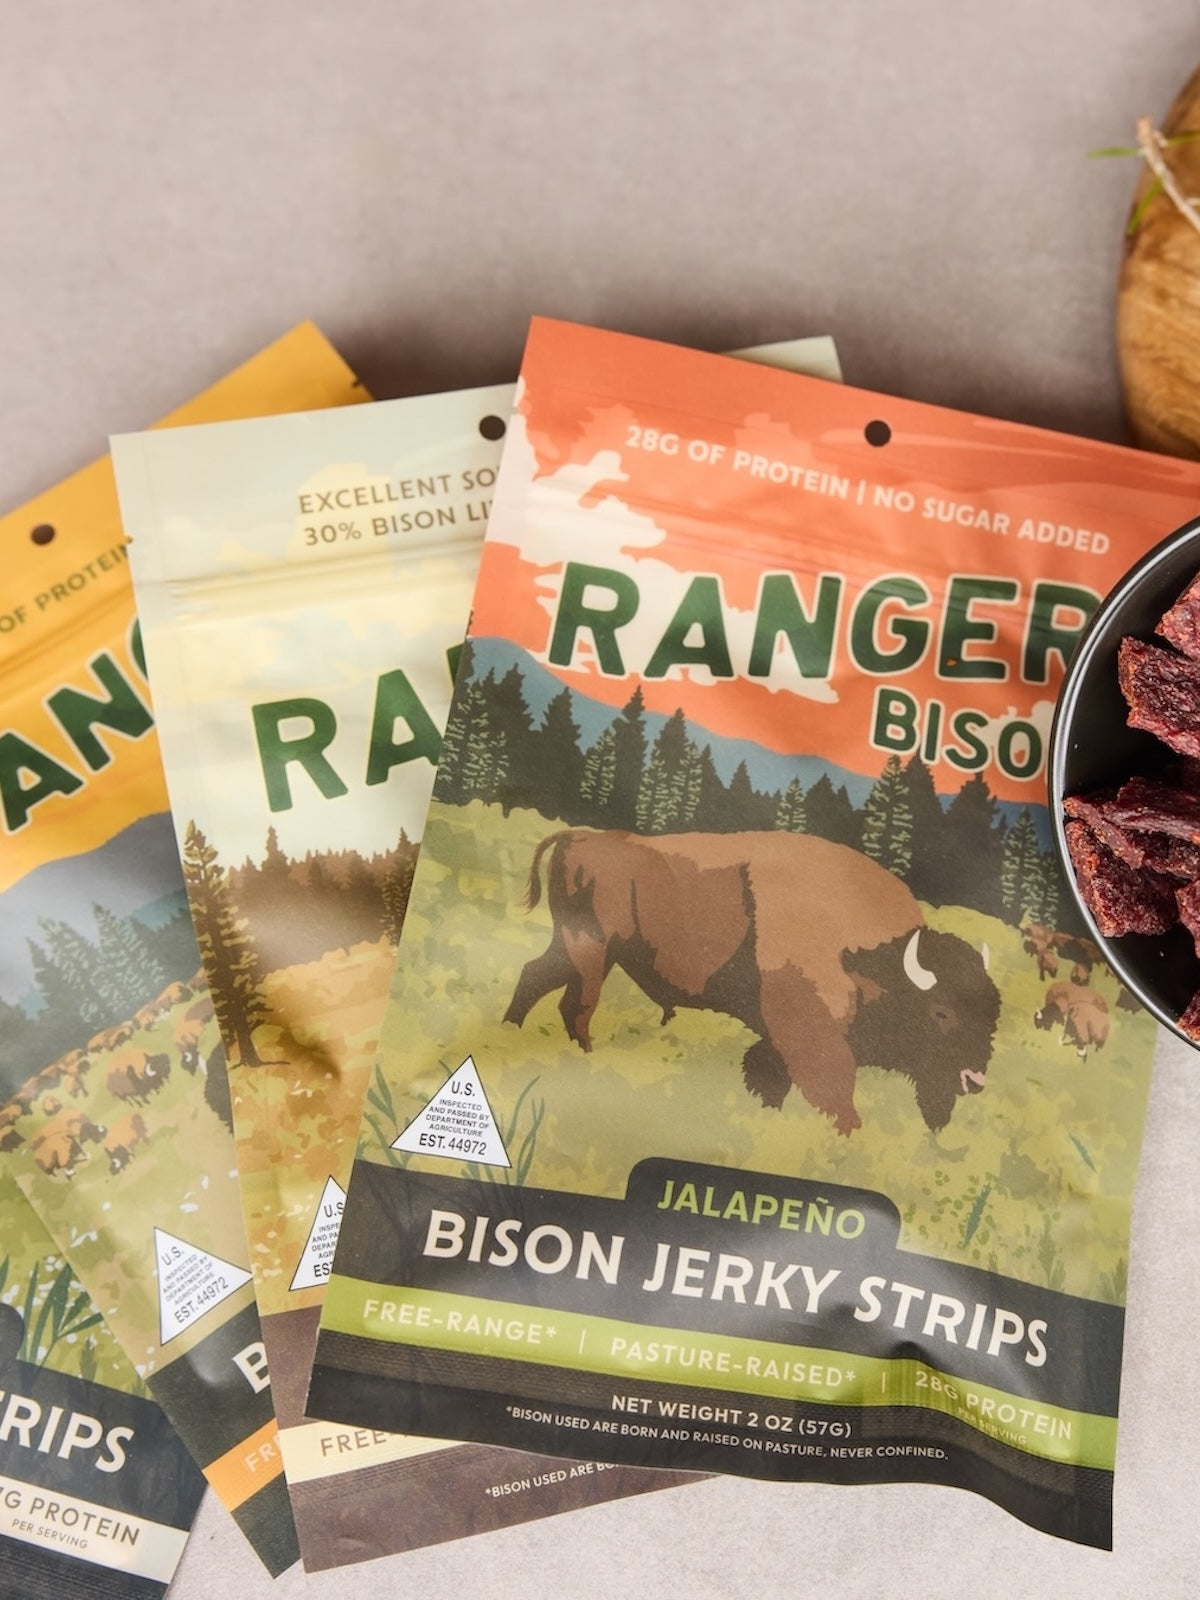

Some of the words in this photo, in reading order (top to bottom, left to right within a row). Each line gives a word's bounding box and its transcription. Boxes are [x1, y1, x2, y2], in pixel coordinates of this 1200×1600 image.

[298, 474, 453, 514] EXCELLENT
[462, 465, 500, 490] SO
[625, 425, 679, 456] 28G
[687, 439, 726, 465] OF
[732, 450, 850, 500] PROTEIN
[873, 484, 916, 513] NO
[922, 498, 1010, 535] SUGAR
[1017, 518, 1111, 555] ADDED
[304, 522, 362, 546] 30%
[371, 507, 456, 537] BISON
[466, 500, 493, 522] LI
[0, 605, 28, 632] OF
[546, 560, 1103, 684] RANGER
[251, 643, 465, 814] RA
[439, 1098, 483, 1112] INSPECTED
[451, 1080, 476, 1097] U.S.
[425, 1113, 478, 1128] DEPARTMENT
[478, 1121, 490, 1130] OF
[428, 1106, 446, 1114] AND
[447, 1108, 478, 1120] PASSED
[479, 1113, 490, 1121] BY
[428, 1123, 483, 1137] AGRICULTURE
[419, 1132, 446, 1150] EST.
[447, 1137, 488, 1156] 44972
[657, 1178, 867, 1240] JALAPEÑO
[161, 1245, 185, 1266] U.S.
[173, 1300, 199, 1324] EST.
[196, 1276, 229, 1306] 44972
[422, 1209, 625, 1285] BISON
[642, 1242, 842, 1314] JERKY
[852, 1275, 1050, 1368] STRIPS
[611, 1394, 652, 1415] NET
[658, 1400, 742, 1425] WEIGHT
[746, 1411, 759, 1428] 2
[764, 1414, 793, 1432] OZ
[798, 1418, 853, 1439] (57G)
[914, 1370, 958, 1401] 28G
[965, 1392, 1073, 1441] PROTEIN
[554, 1415, 590, 1431] USED
[592, 1419, 618, 1434] ARE
[620, 1423, 658, 1439] BORN
[660, 1428, 690, 1442] AND
[692, 1431, 740, 1447] RAISED
[742, 1436, 763, 1451] ON
[765, 1440, 827, 1457] PASTURE,
[830, 1447, 873, 1459] NEVER
[875, 1445, 949, 1461] CONFINED.
[979, 1418, 1027, 1445] SERVING
[533, 1471, 568, 1488] USED
[569, 1462, 595, 1479] ARE
[11, 1518, 35, 1535] PER
[37, 1525, 89, 1549] SERVING
[29, 1496, 141, 1547] PROTEIN
